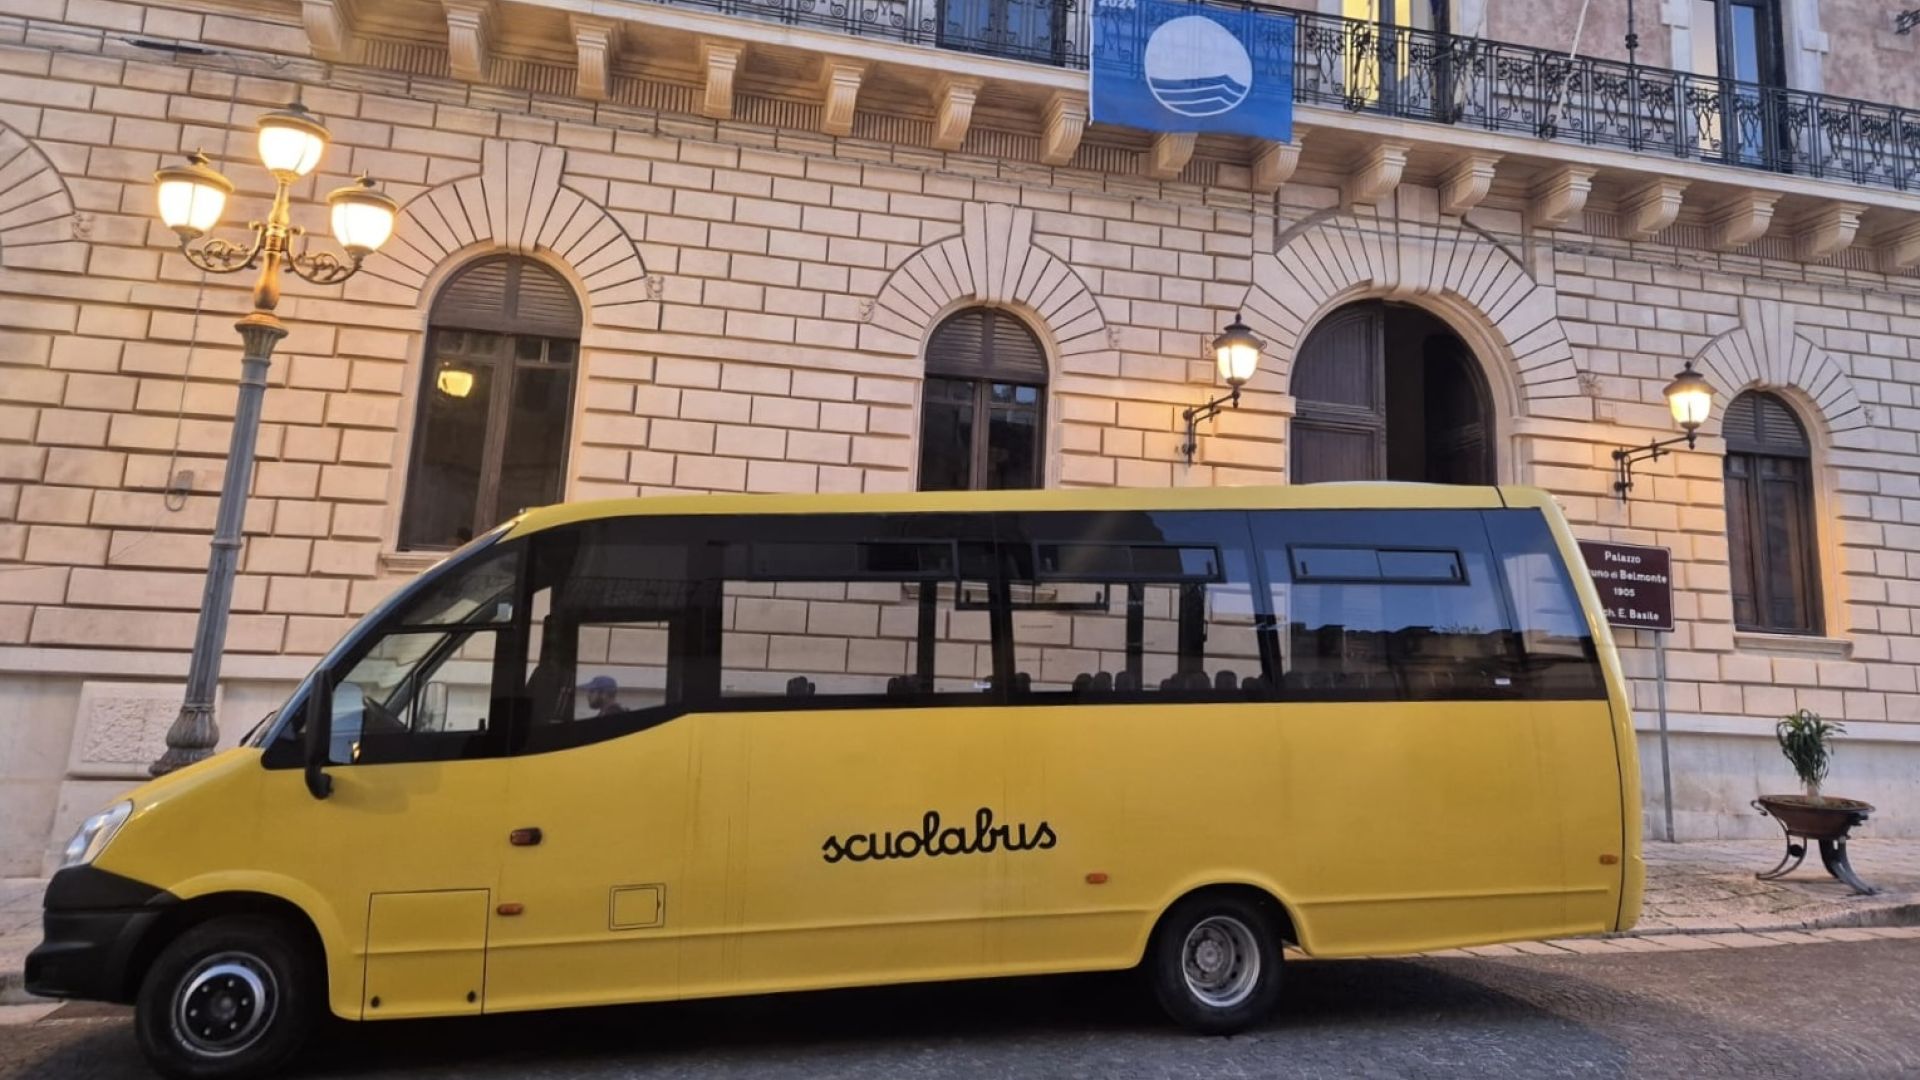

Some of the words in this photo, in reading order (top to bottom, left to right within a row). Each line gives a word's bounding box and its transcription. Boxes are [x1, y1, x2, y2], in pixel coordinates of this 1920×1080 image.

[1604, 550, 1641, 564] Palazzo
[1590, 569, 1609, 578] uno
[1610, 571, 1618, 579] di
[1620, 570, 1667, 584] Belmonte
[1614, 587, 1635, 597] 1905
[1602, 608, 1616, 618] ch.
[1618, 608, 1627, 619] E.
[1629, 609, 1659, 621] Basile
[821, 806, 1057, 863] scuolabus
